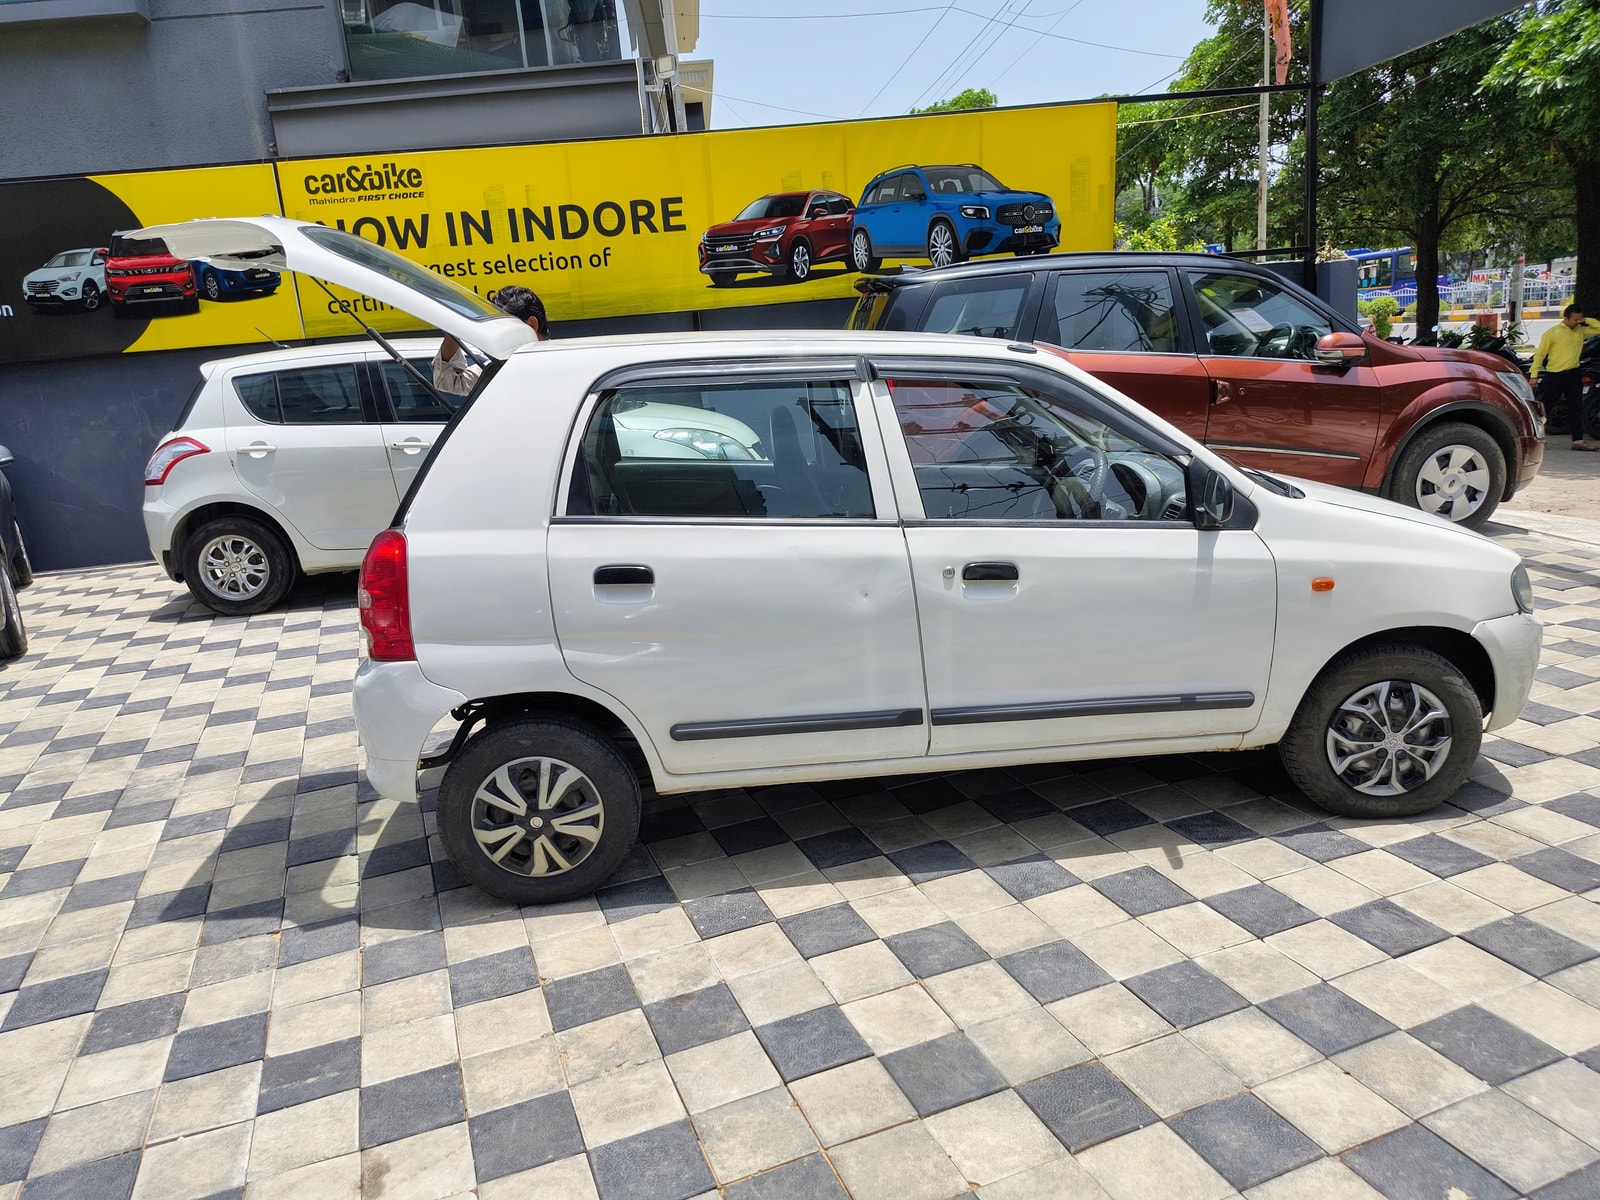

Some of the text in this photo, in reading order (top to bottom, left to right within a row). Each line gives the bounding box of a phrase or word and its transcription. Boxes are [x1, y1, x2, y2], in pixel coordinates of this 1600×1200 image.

[304, 163, 423, 195] car&bike
[309, 191, 425, 206] Mahindra FIRST CHOICE
[445, 210, 494, 247] IN
[507, 197, 687, 243] INDORE
[1014, 225, 1043, 234] car&bike
[483, 251, 582, 275] selection
[589, 247, 612, 268] of
